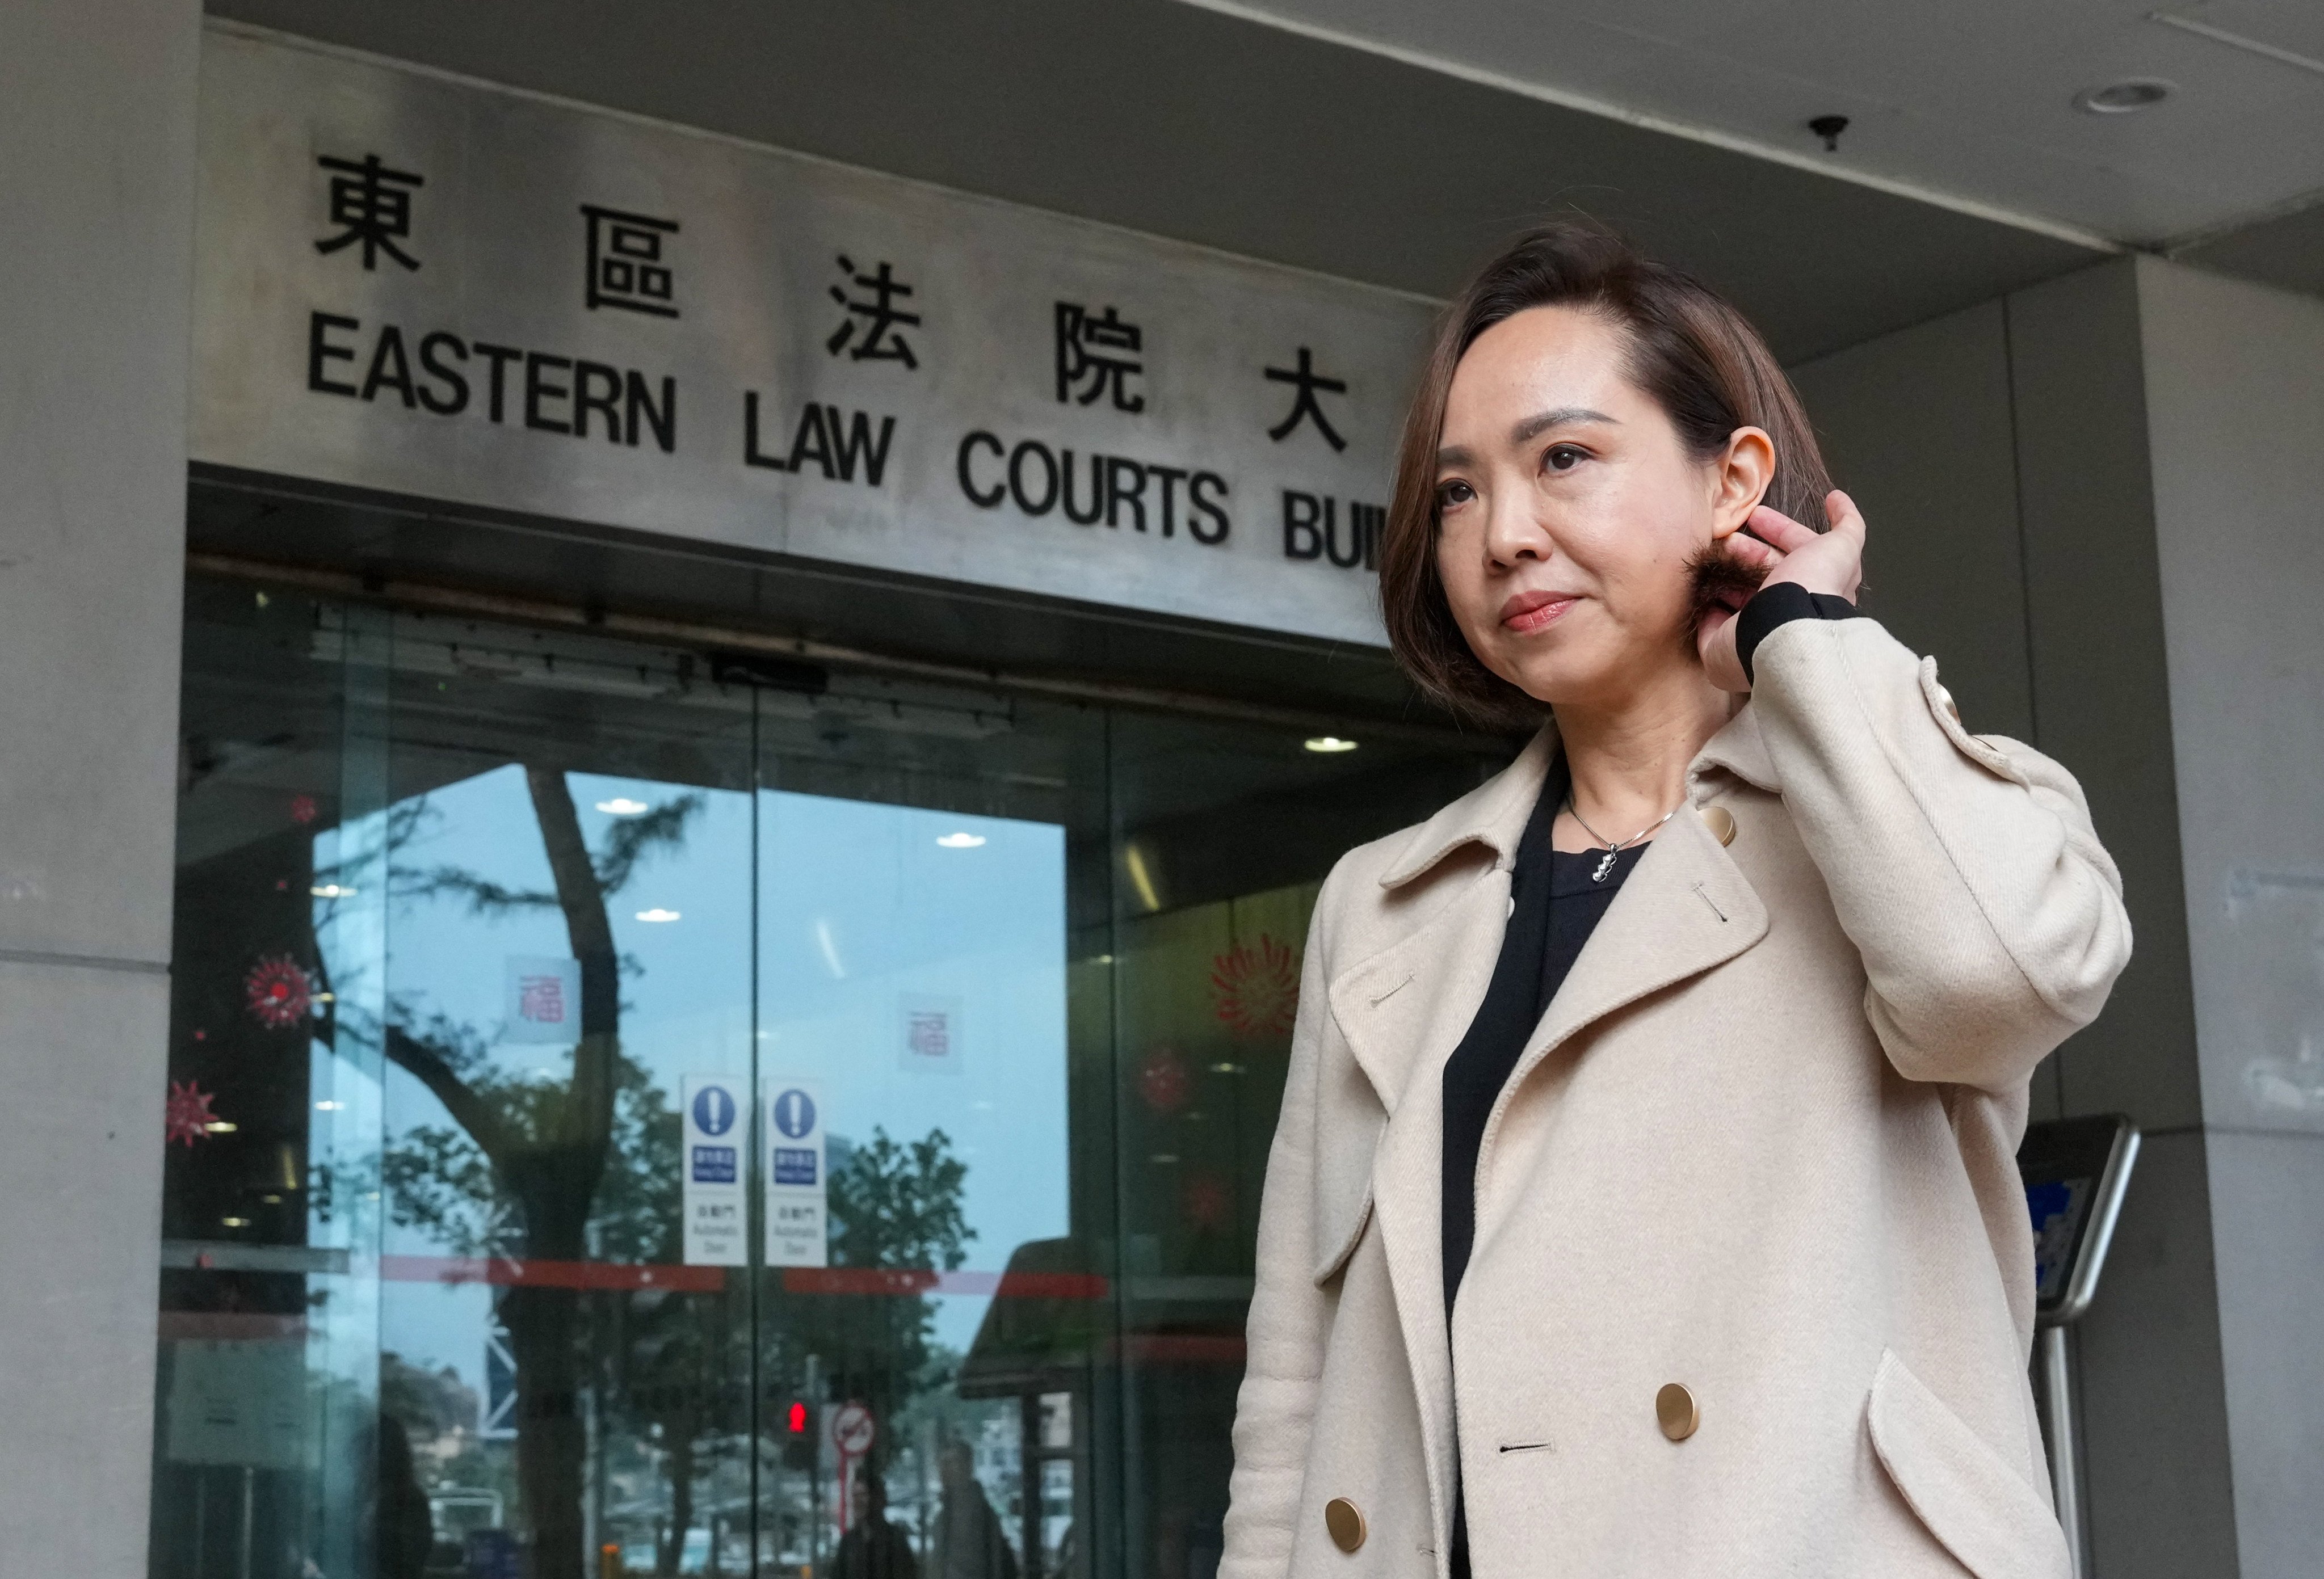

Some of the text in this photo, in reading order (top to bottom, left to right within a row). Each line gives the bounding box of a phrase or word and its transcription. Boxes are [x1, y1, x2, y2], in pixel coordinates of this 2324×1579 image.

[307, 310, 676, 454] EASTERN
[743, 389, 896, 488] LAW
[956, 429, 1230, 548] COURTS
